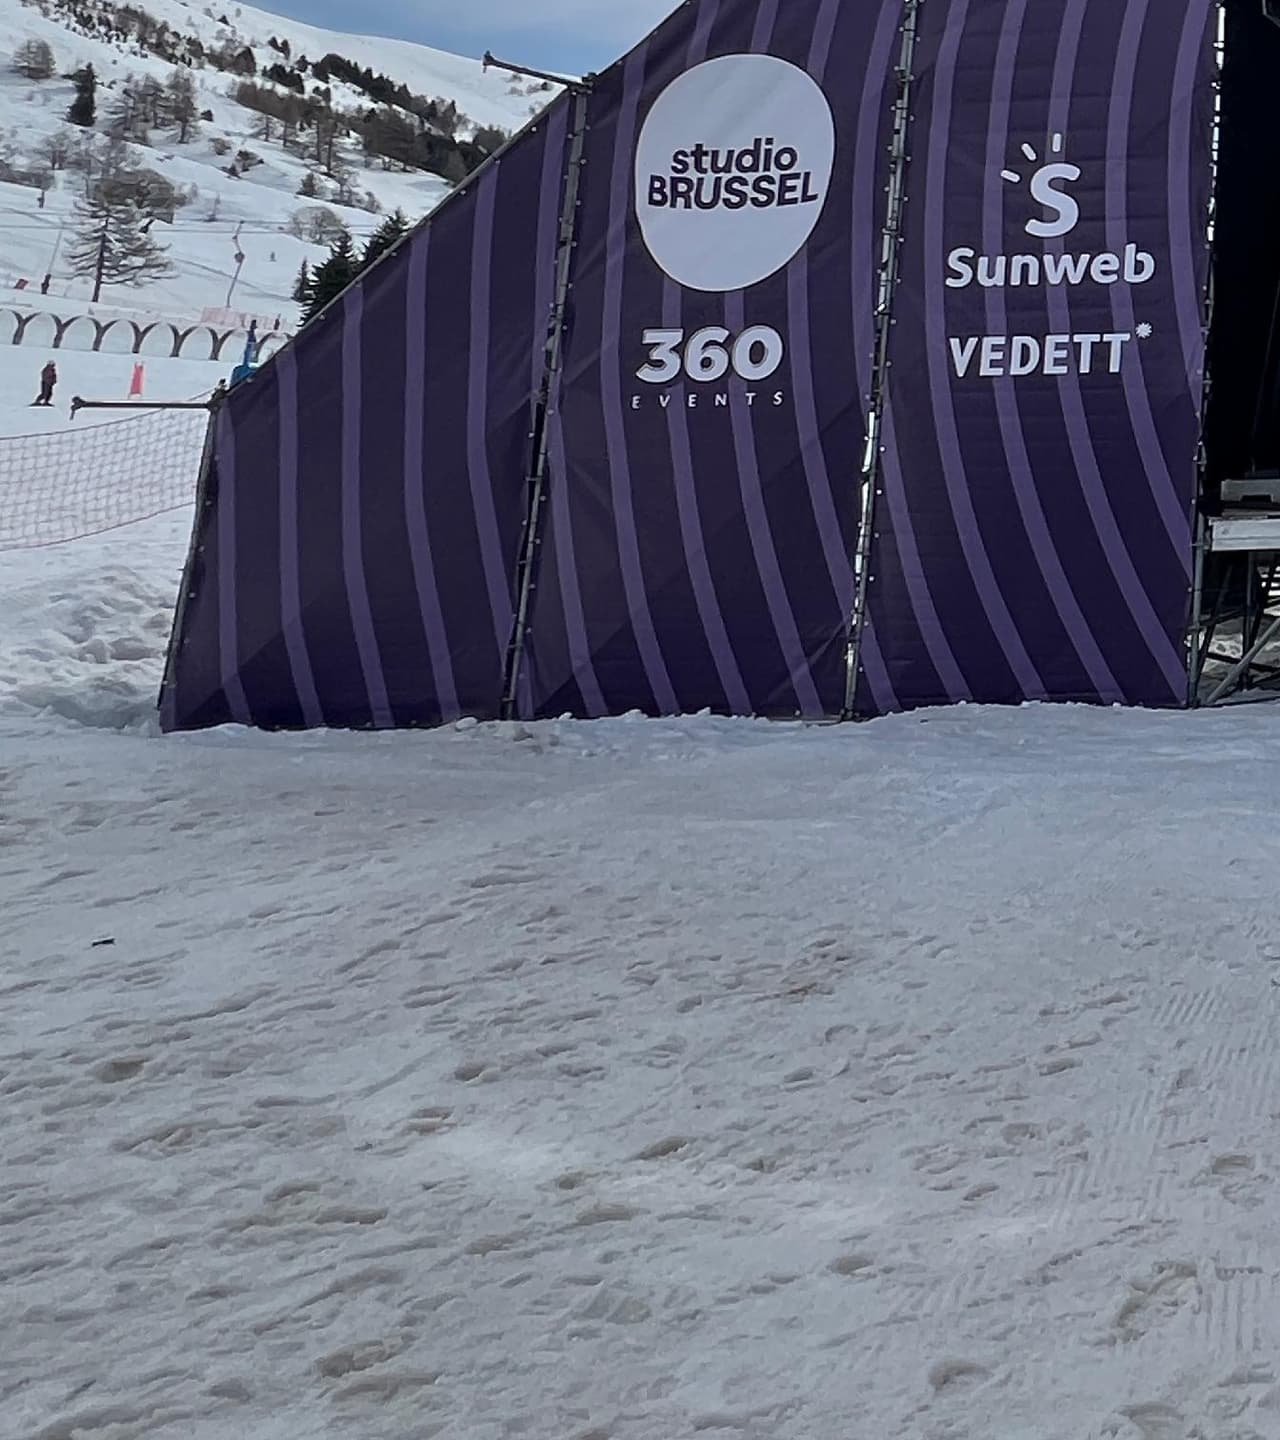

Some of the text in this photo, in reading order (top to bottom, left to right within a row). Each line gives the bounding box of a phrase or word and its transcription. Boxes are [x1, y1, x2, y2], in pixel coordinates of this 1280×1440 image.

[670, 137, 798, 175] studio
[647, 171, 819, 210] BRUSSEL
[945, 244, 1156, 290] Sunweb
[635, 324, 784, 383] 360
[631, 391, 784, 410] EVENTS
